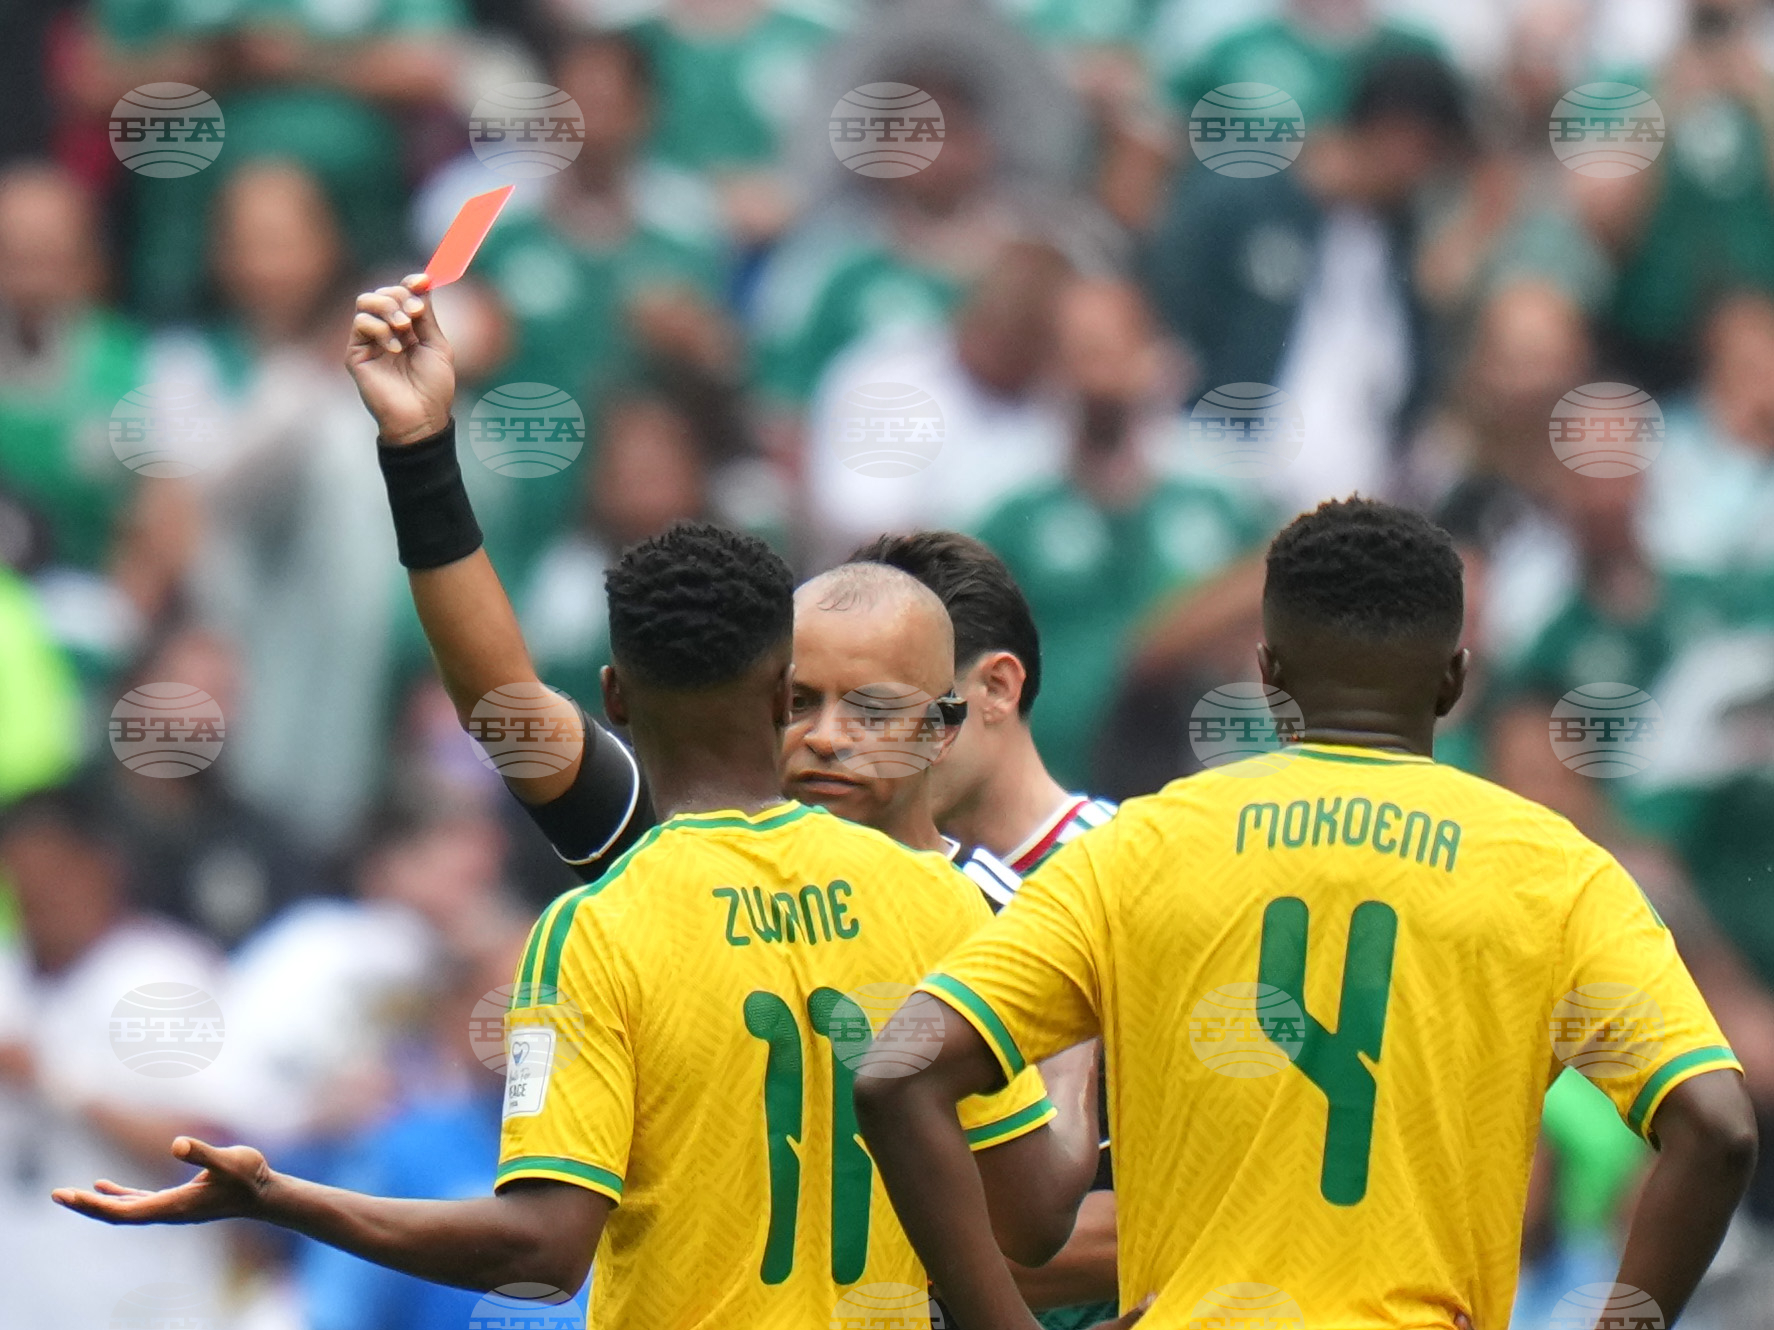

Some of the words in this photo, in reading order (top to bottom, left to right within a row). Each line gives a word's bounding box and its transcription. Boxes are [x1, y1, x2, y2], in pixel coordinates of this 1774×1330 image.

[712, 879, 860, 946] ZWANE
[1236, 796, 1462, 873] MOKOENA
[743, 987, 876, 1286] 11
[1256, 896, 1399, 1206] 4
